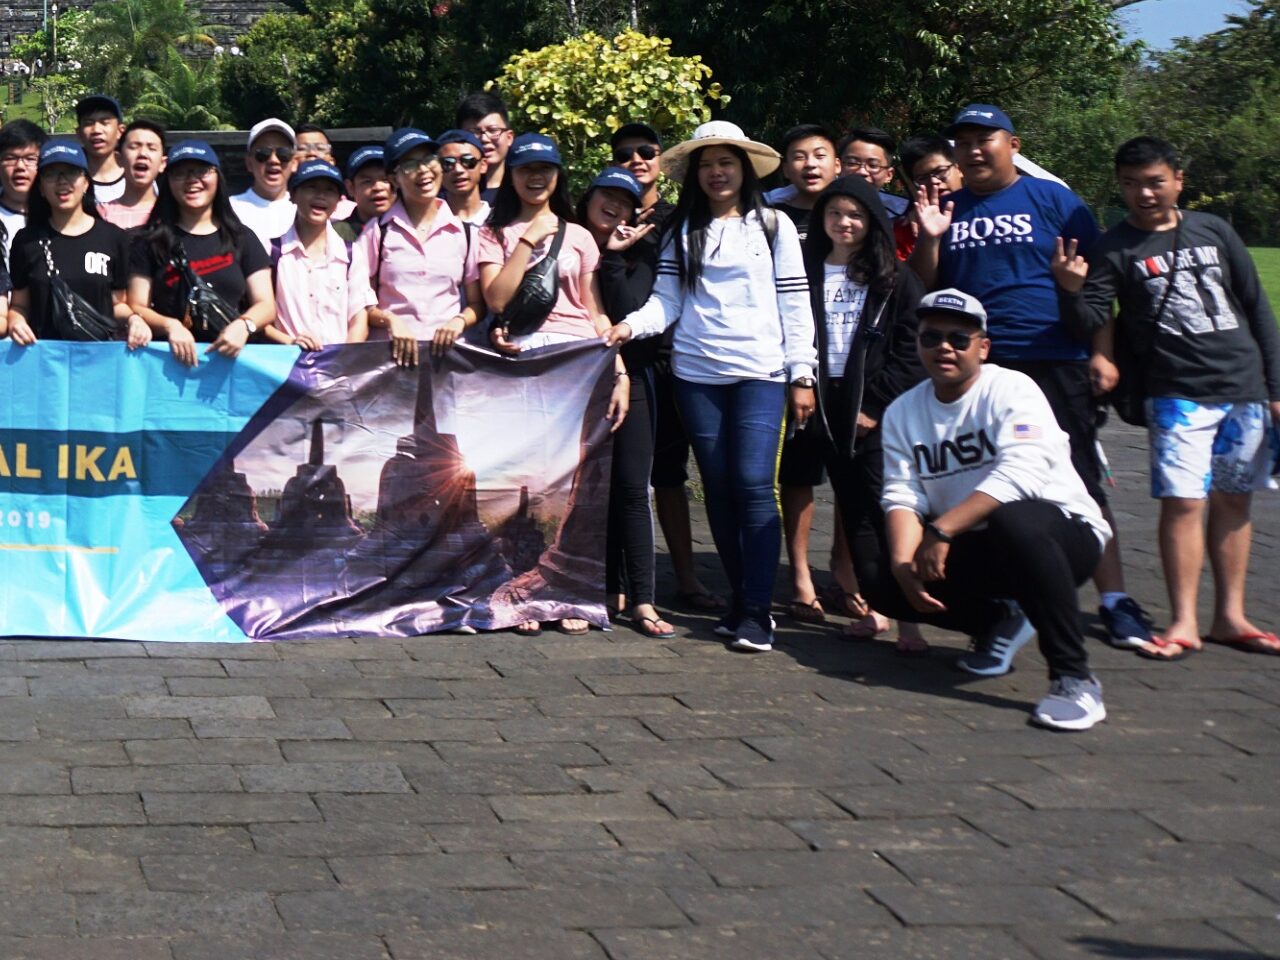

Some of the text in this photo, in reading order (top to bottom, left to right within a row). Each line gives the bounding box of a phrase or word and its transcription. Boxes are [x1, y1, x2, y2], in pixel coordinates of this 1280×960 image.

[950, 214, 1033, 243] BOSS
[950, 241, 986, 250] HUGO
[58, 445, 137, 482] IKA
[913, 429, 996, 474] NASA
